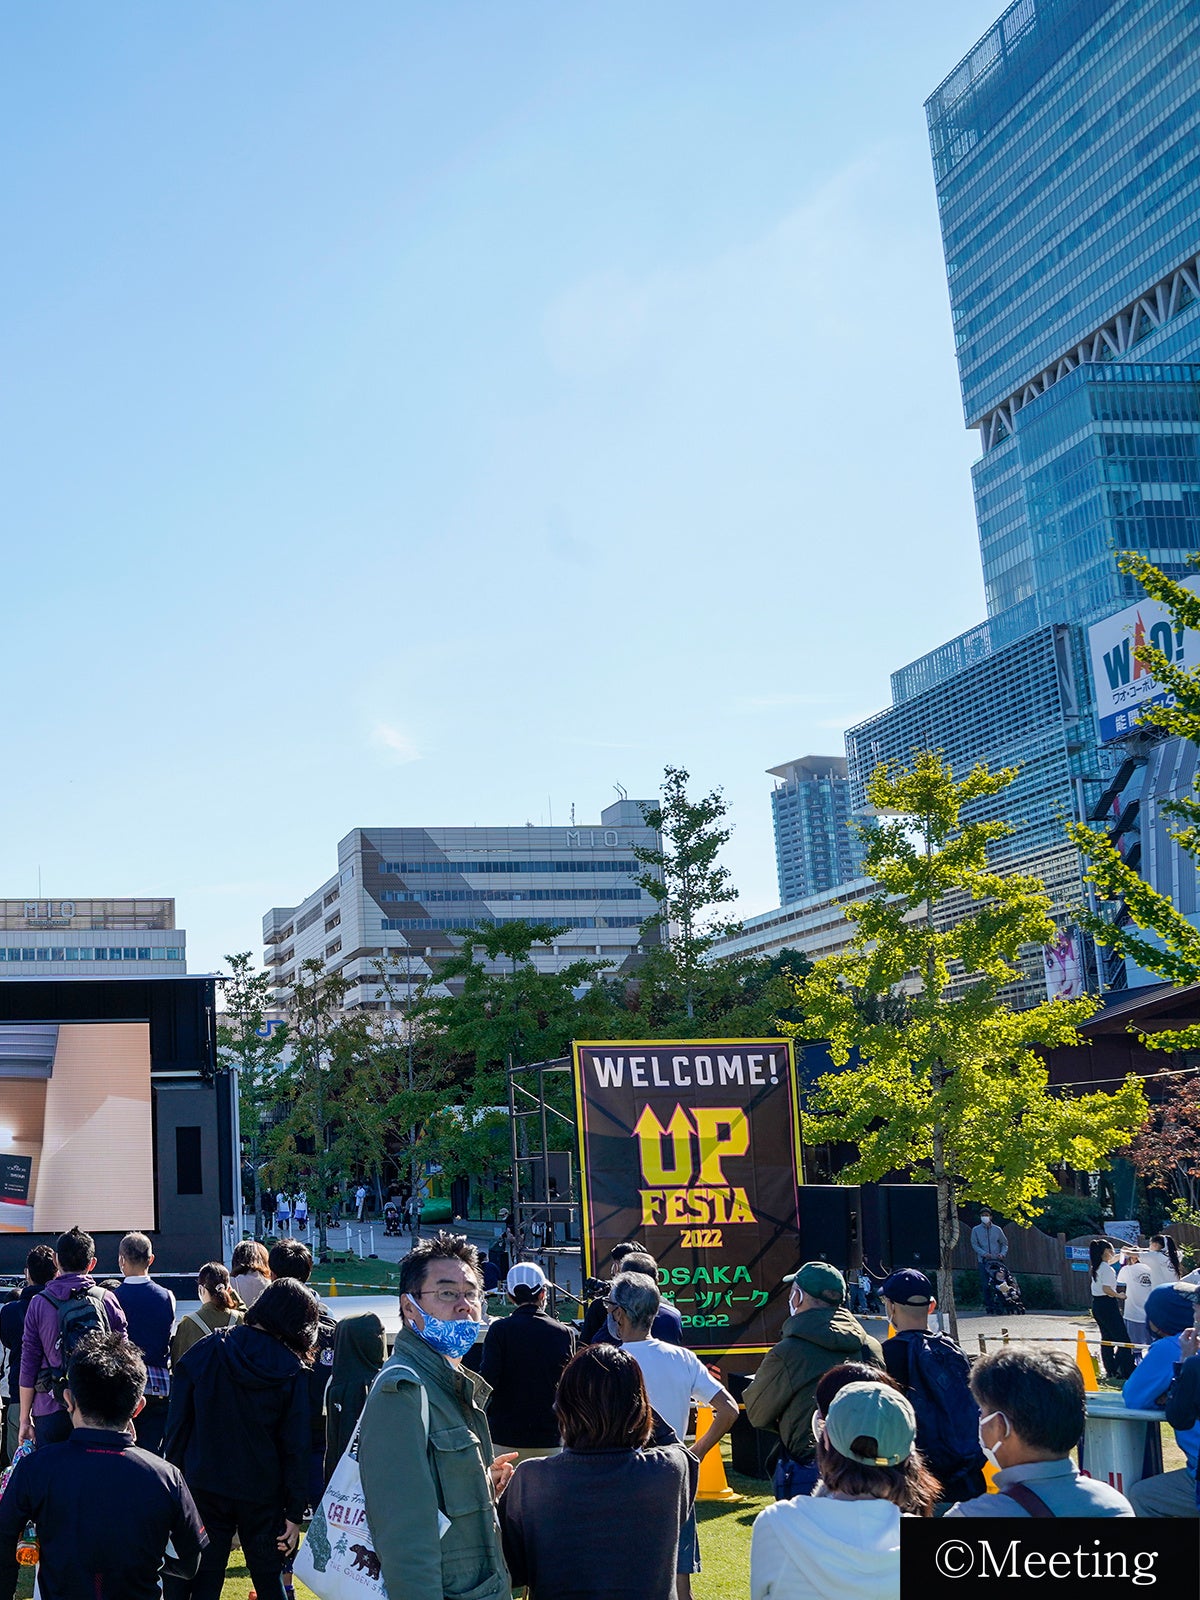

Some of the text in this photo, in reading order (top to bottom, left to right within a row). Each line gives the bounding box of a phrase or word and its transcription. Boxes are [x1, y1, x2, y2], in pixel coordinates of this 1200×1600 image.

[1103, 610, 1185, 690] WAO!
[566, 830, 618, 847] MIO
[23, 899, 76, 918] MIO
[593, 1055, 779, 1087] WELCOME!
[631, 1102, 750, 1187] UP
[638, 1187, 758, 1226] FESTA
[680, 1229, 723, 1248] 2022
[657, 1265, 752, 1286] OSAKA
[681, 1313, 730, 1328] 2022
[344, 1567, 370, 1587] GOLDEN
